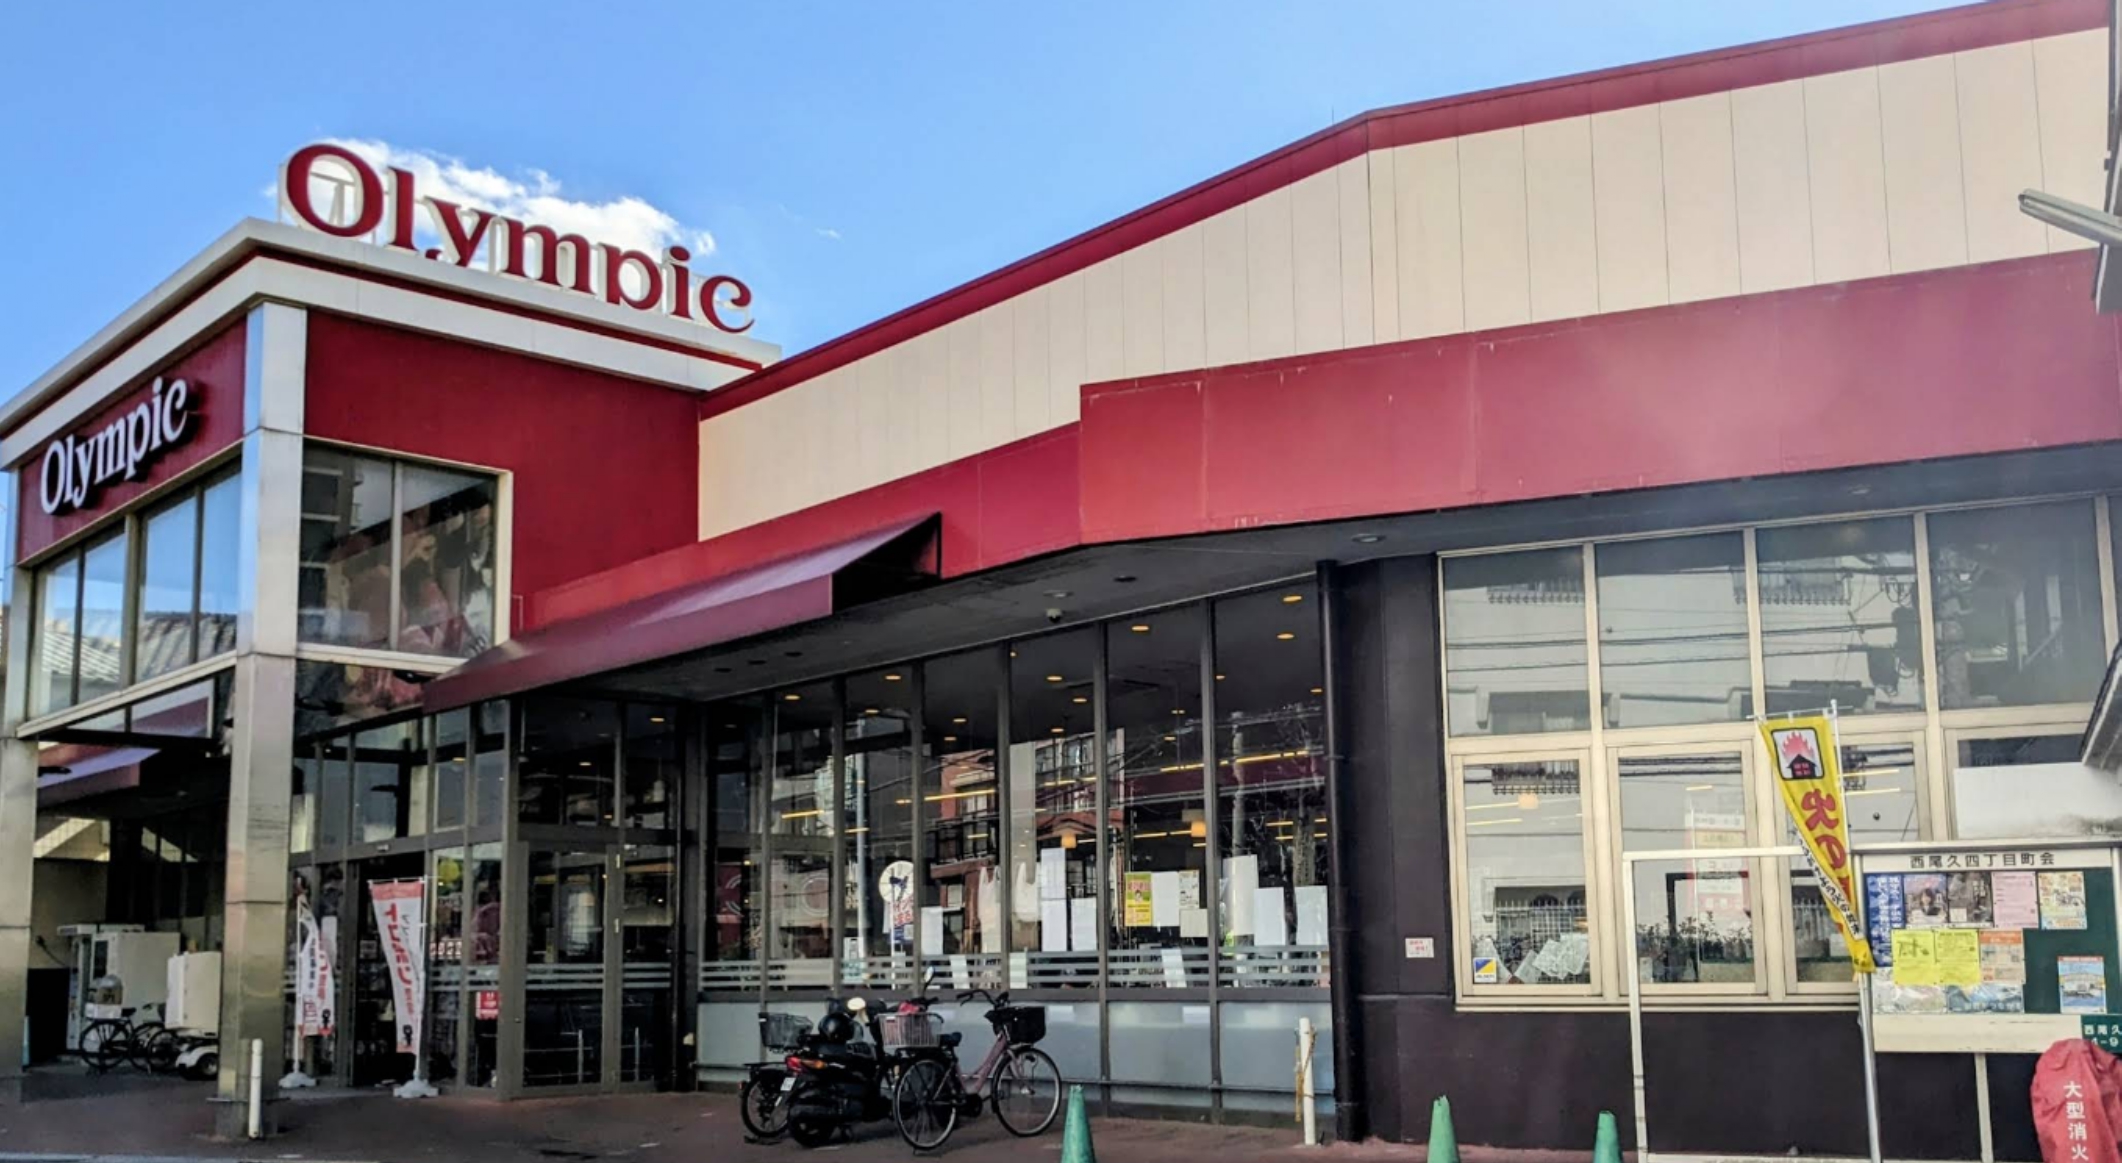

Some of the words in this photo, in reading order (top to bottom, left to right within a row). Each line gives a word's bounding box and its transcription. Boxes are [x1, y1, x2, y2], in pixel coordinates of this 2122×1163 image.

[283, 143, 755, 333] Olympic
[40, 376, 188, 514] Olympic
[1910, 852, 2055, 869] 西尾久四丁目町会
[2084, 1024, 2122, 1035] 西尾久
[2063, 1081, 2089, 1162] 大型消火
